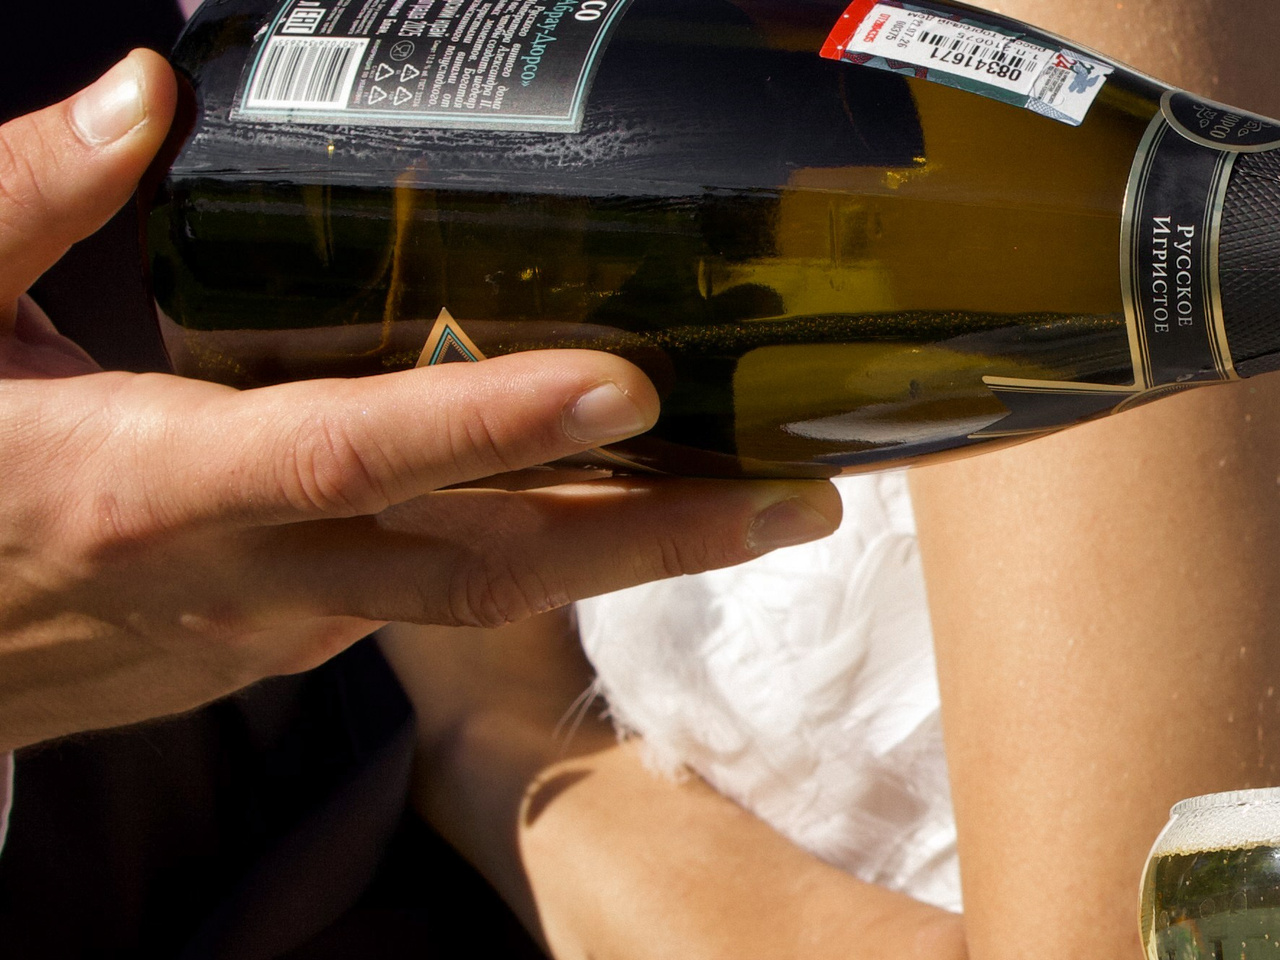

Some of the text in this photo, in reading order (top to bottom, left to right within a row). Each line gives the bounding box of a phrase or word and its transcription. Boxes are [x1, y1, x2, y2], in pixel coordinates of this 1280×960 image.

[428, 45, 457, 108] полусладкого.
[440, 3, 493, 108] игристыми винами от
[477, 39, 498, 74] создать
[481, 45, 511, 96] Александра
[492, 6, 546, 110] Русского винного дома
[930, 47, 1022, 82] 08341671
[453, 68, 477, 109] Богатая
[462, 75, 484, 109] шедевр
